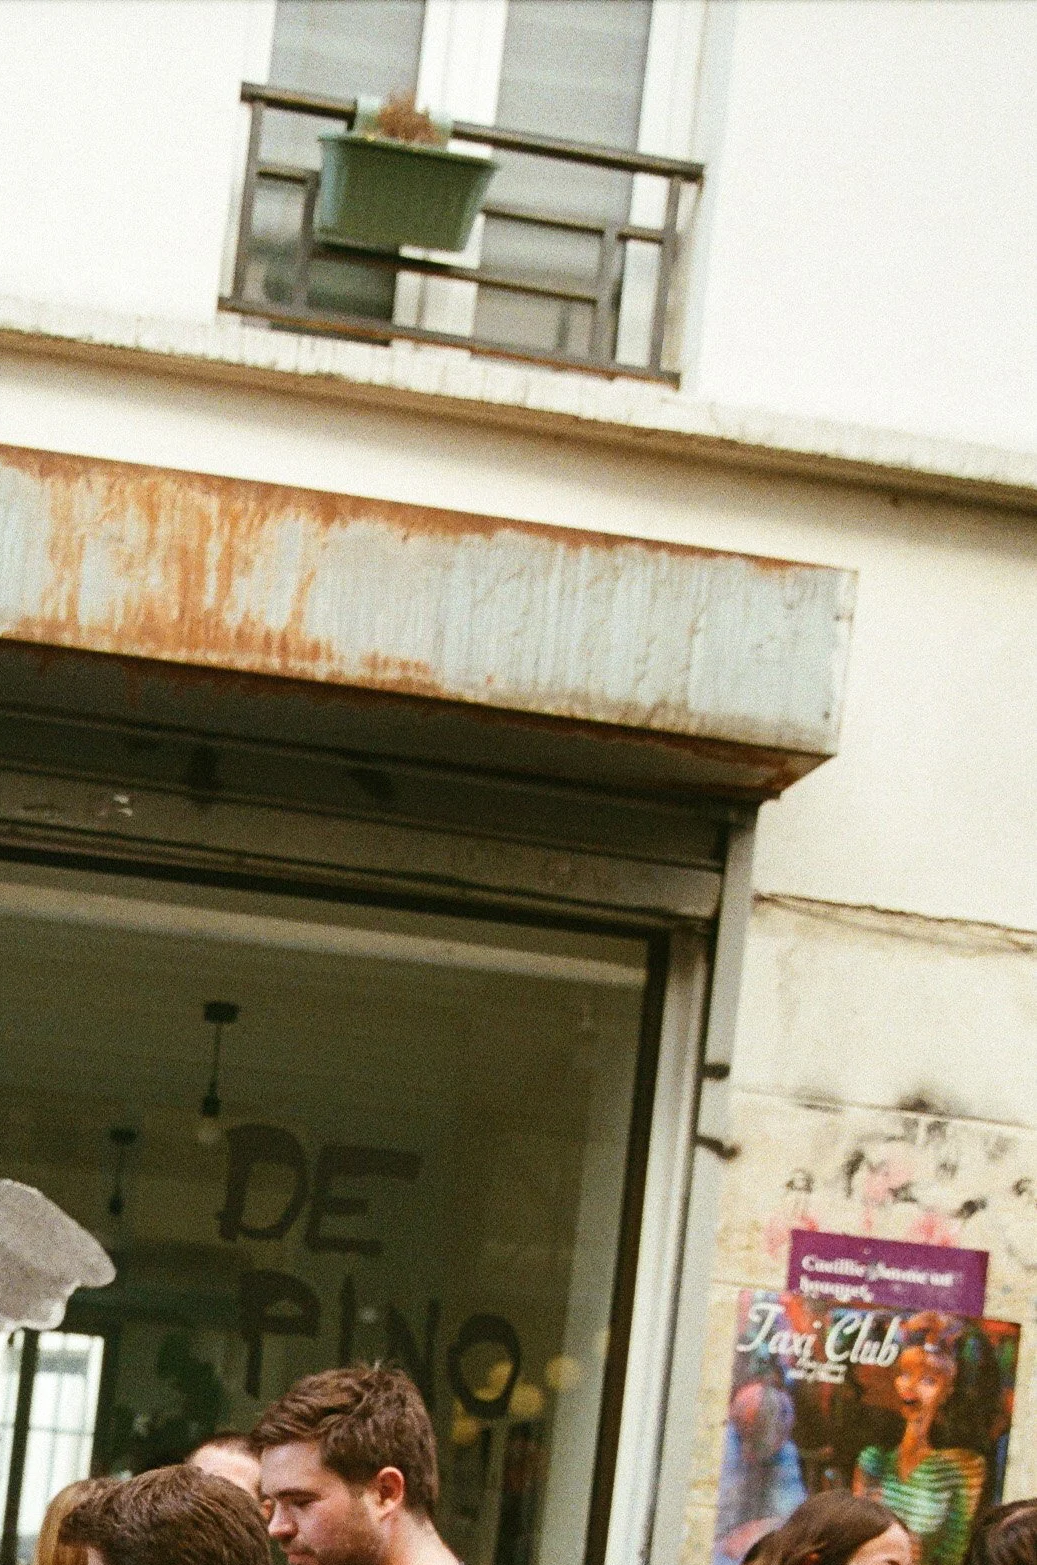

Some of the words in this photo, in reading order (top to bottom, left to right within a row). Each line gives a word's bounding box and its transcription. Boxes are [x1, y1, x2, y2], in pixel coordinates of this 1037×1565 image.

[216, 1123, 425, 1256] DE
[238, 1268, 523, 1420] PINO
[736, 1301, 822, 1357] Taxi
[825, 1311, 902, 1368] Club
